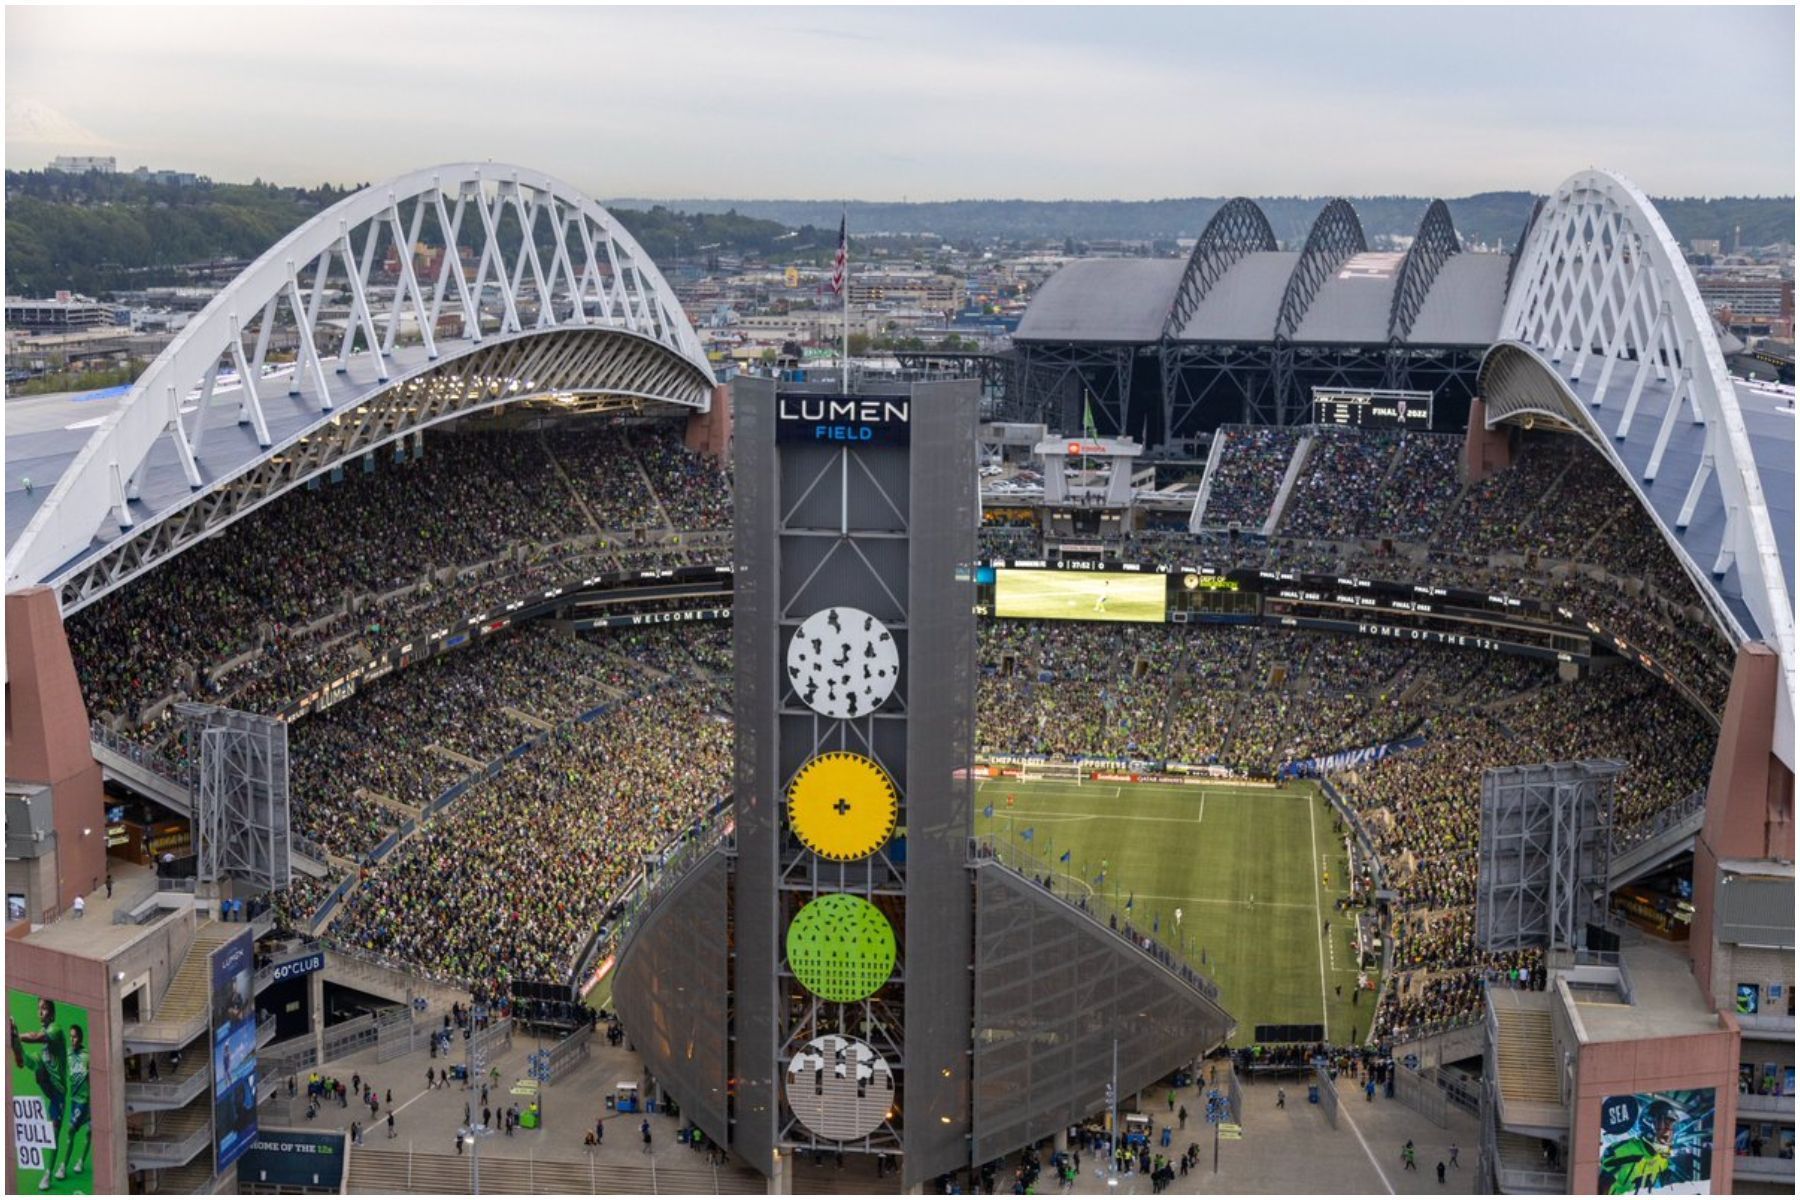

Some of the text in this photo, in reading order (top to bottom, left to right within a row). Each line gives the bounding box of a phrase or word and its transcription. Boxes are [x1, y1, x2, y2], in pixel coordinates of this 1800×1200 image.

[780, 399, 908, 422] LUMEN
[1372, 407, 1428, 418] FINAL 2022
[815, 425, 872, 440] FIELD
[632, 609, 731, 624] WELCOME TO
[1359, 625, 1401, 637] HOME
[1411, 630, 1429, 640] OF
[1438, 632, 1466, 646] THE
[13, 1099, 45, 1120] OUR
[1608, 1103, 1630, 1125] SEA
[16, 1123, 52, 1144] FULL
[20, 1145, 41, 1167] 90
[280, 1143, 294, 1153] OF
[294, 1143, 316, 1154] THE
